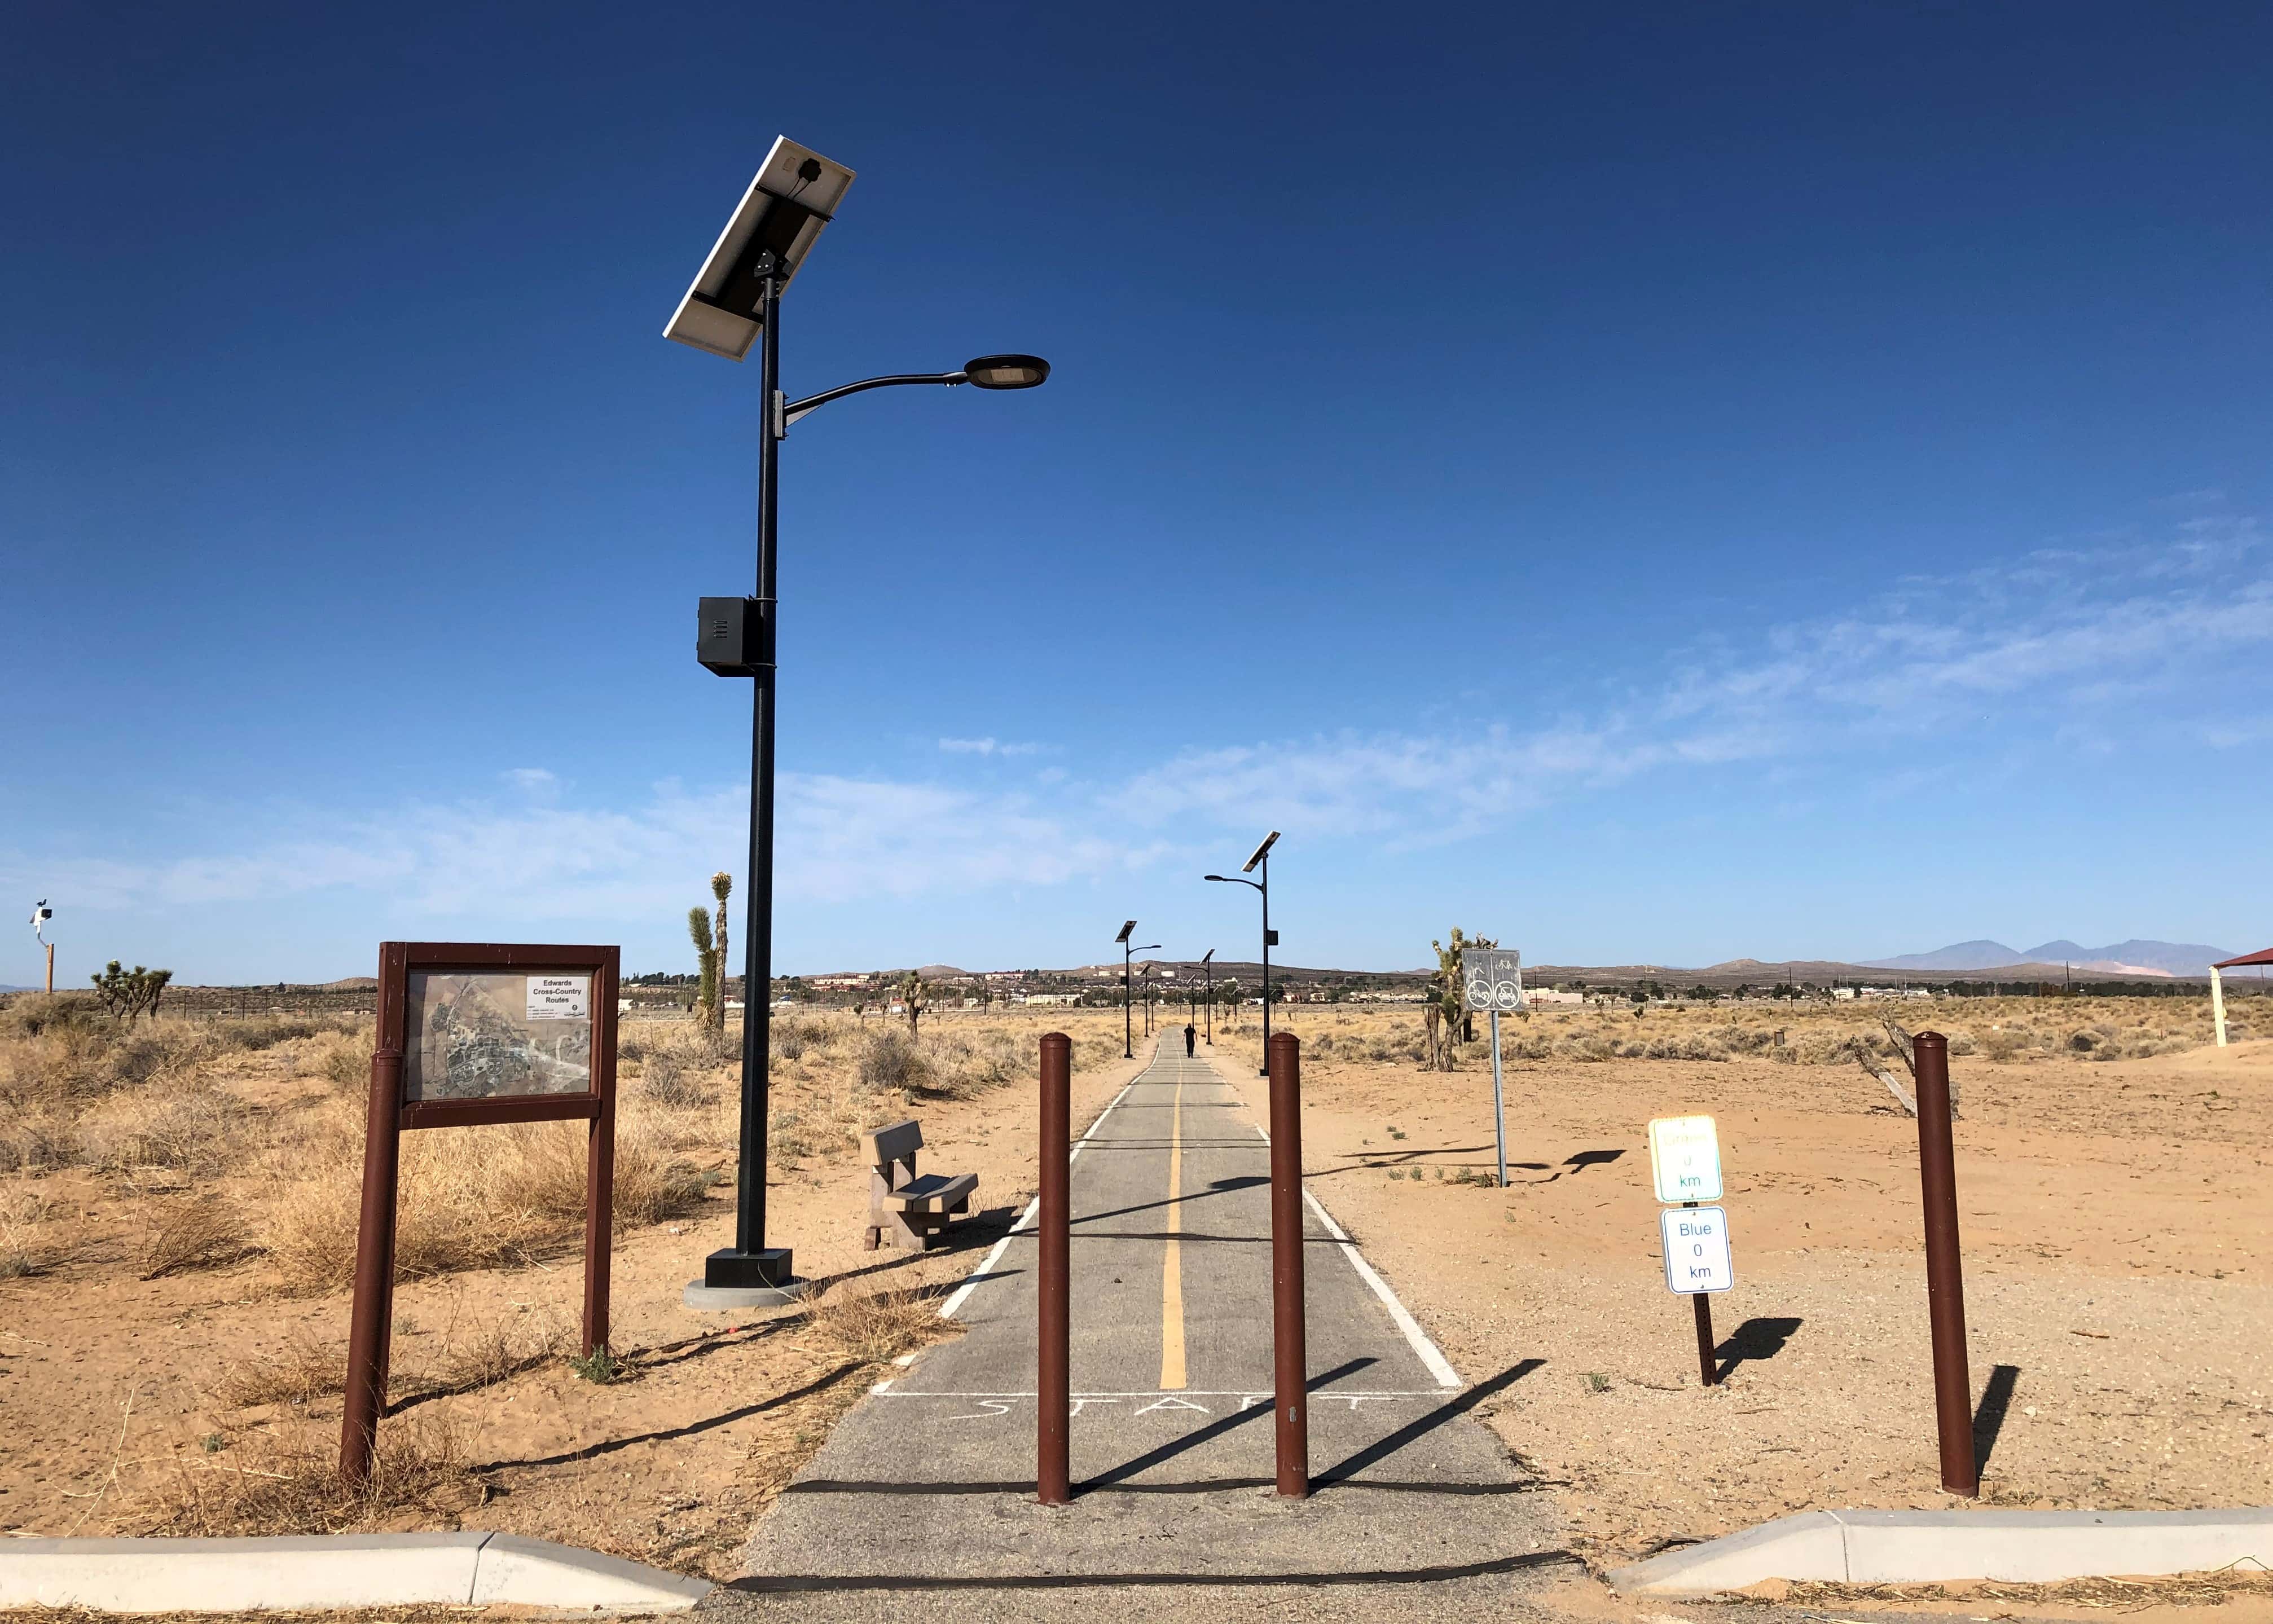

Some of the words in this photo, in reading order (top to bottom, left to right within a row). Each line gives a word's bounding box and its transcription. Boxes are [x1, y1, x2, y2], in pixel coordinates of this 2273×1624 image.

[1680, 1174, 1700, 1187] km
[1680, 1223, 1712, 1236] Blue
[1694, 1244, 1702, 1257] 0
[1690, 1266, 1711, 1279] km
